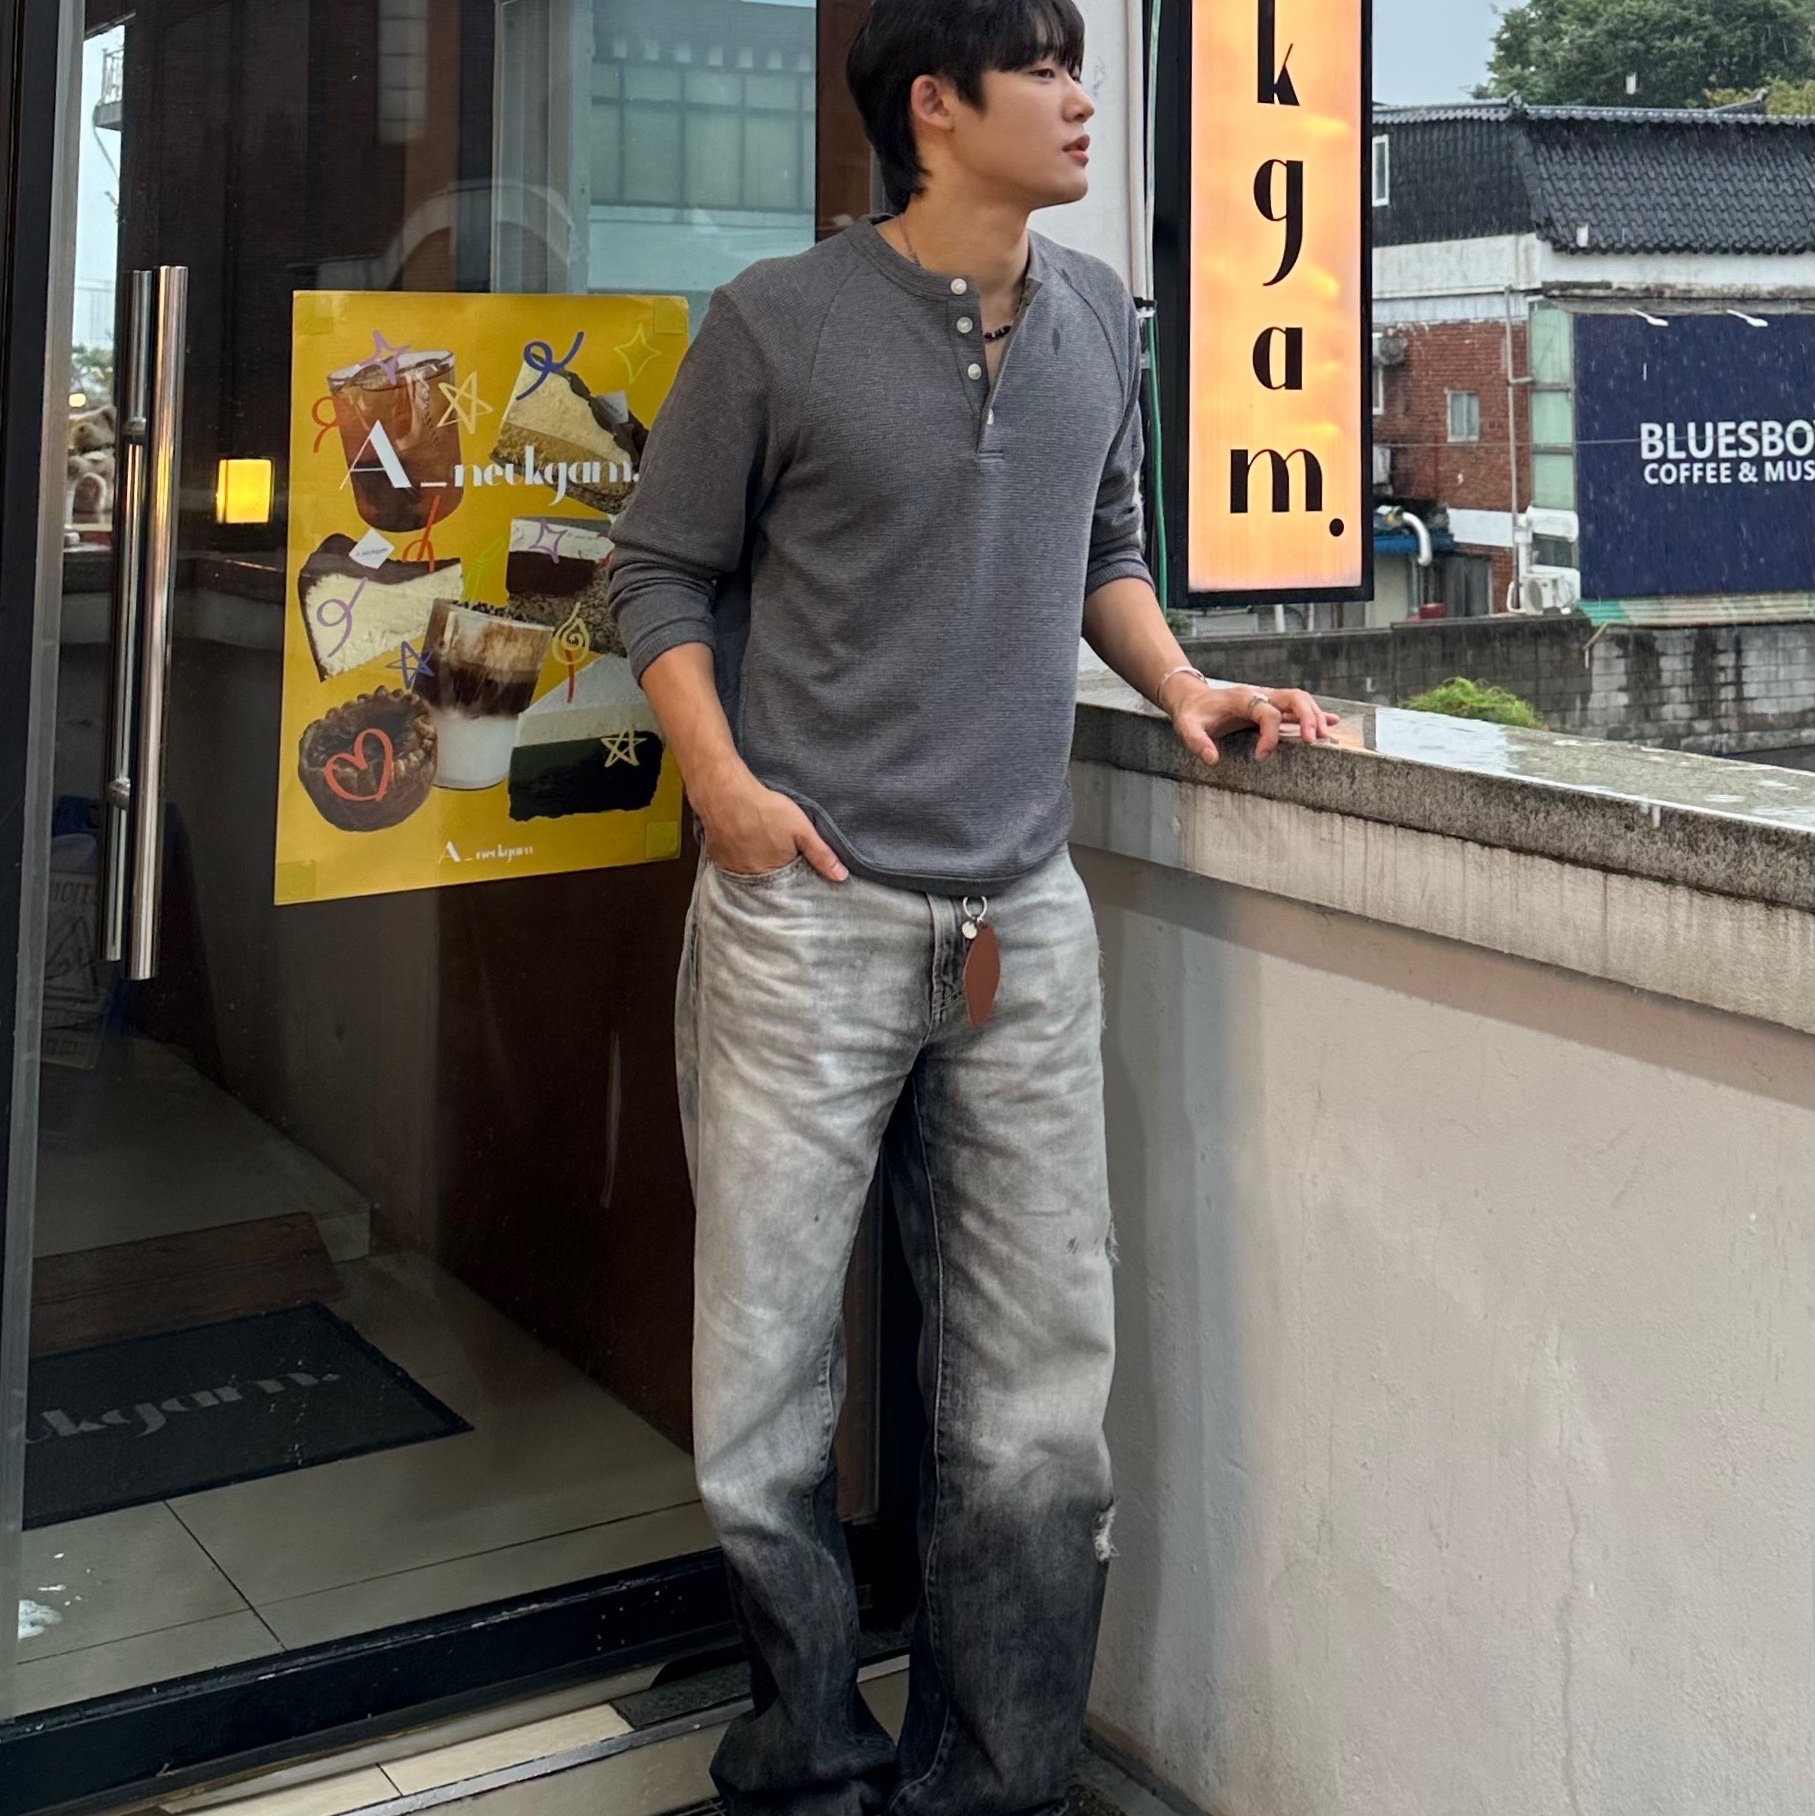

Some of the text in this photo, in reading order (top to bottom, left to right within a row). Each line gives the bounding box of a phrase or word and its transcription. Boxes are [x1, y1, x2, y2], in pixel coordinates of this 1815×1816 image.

[1640, 419, 1815, 460] BLUESBO
[1644, 462, 1732, 485] COFFEE
[1738, 461, 1758, 483] &
